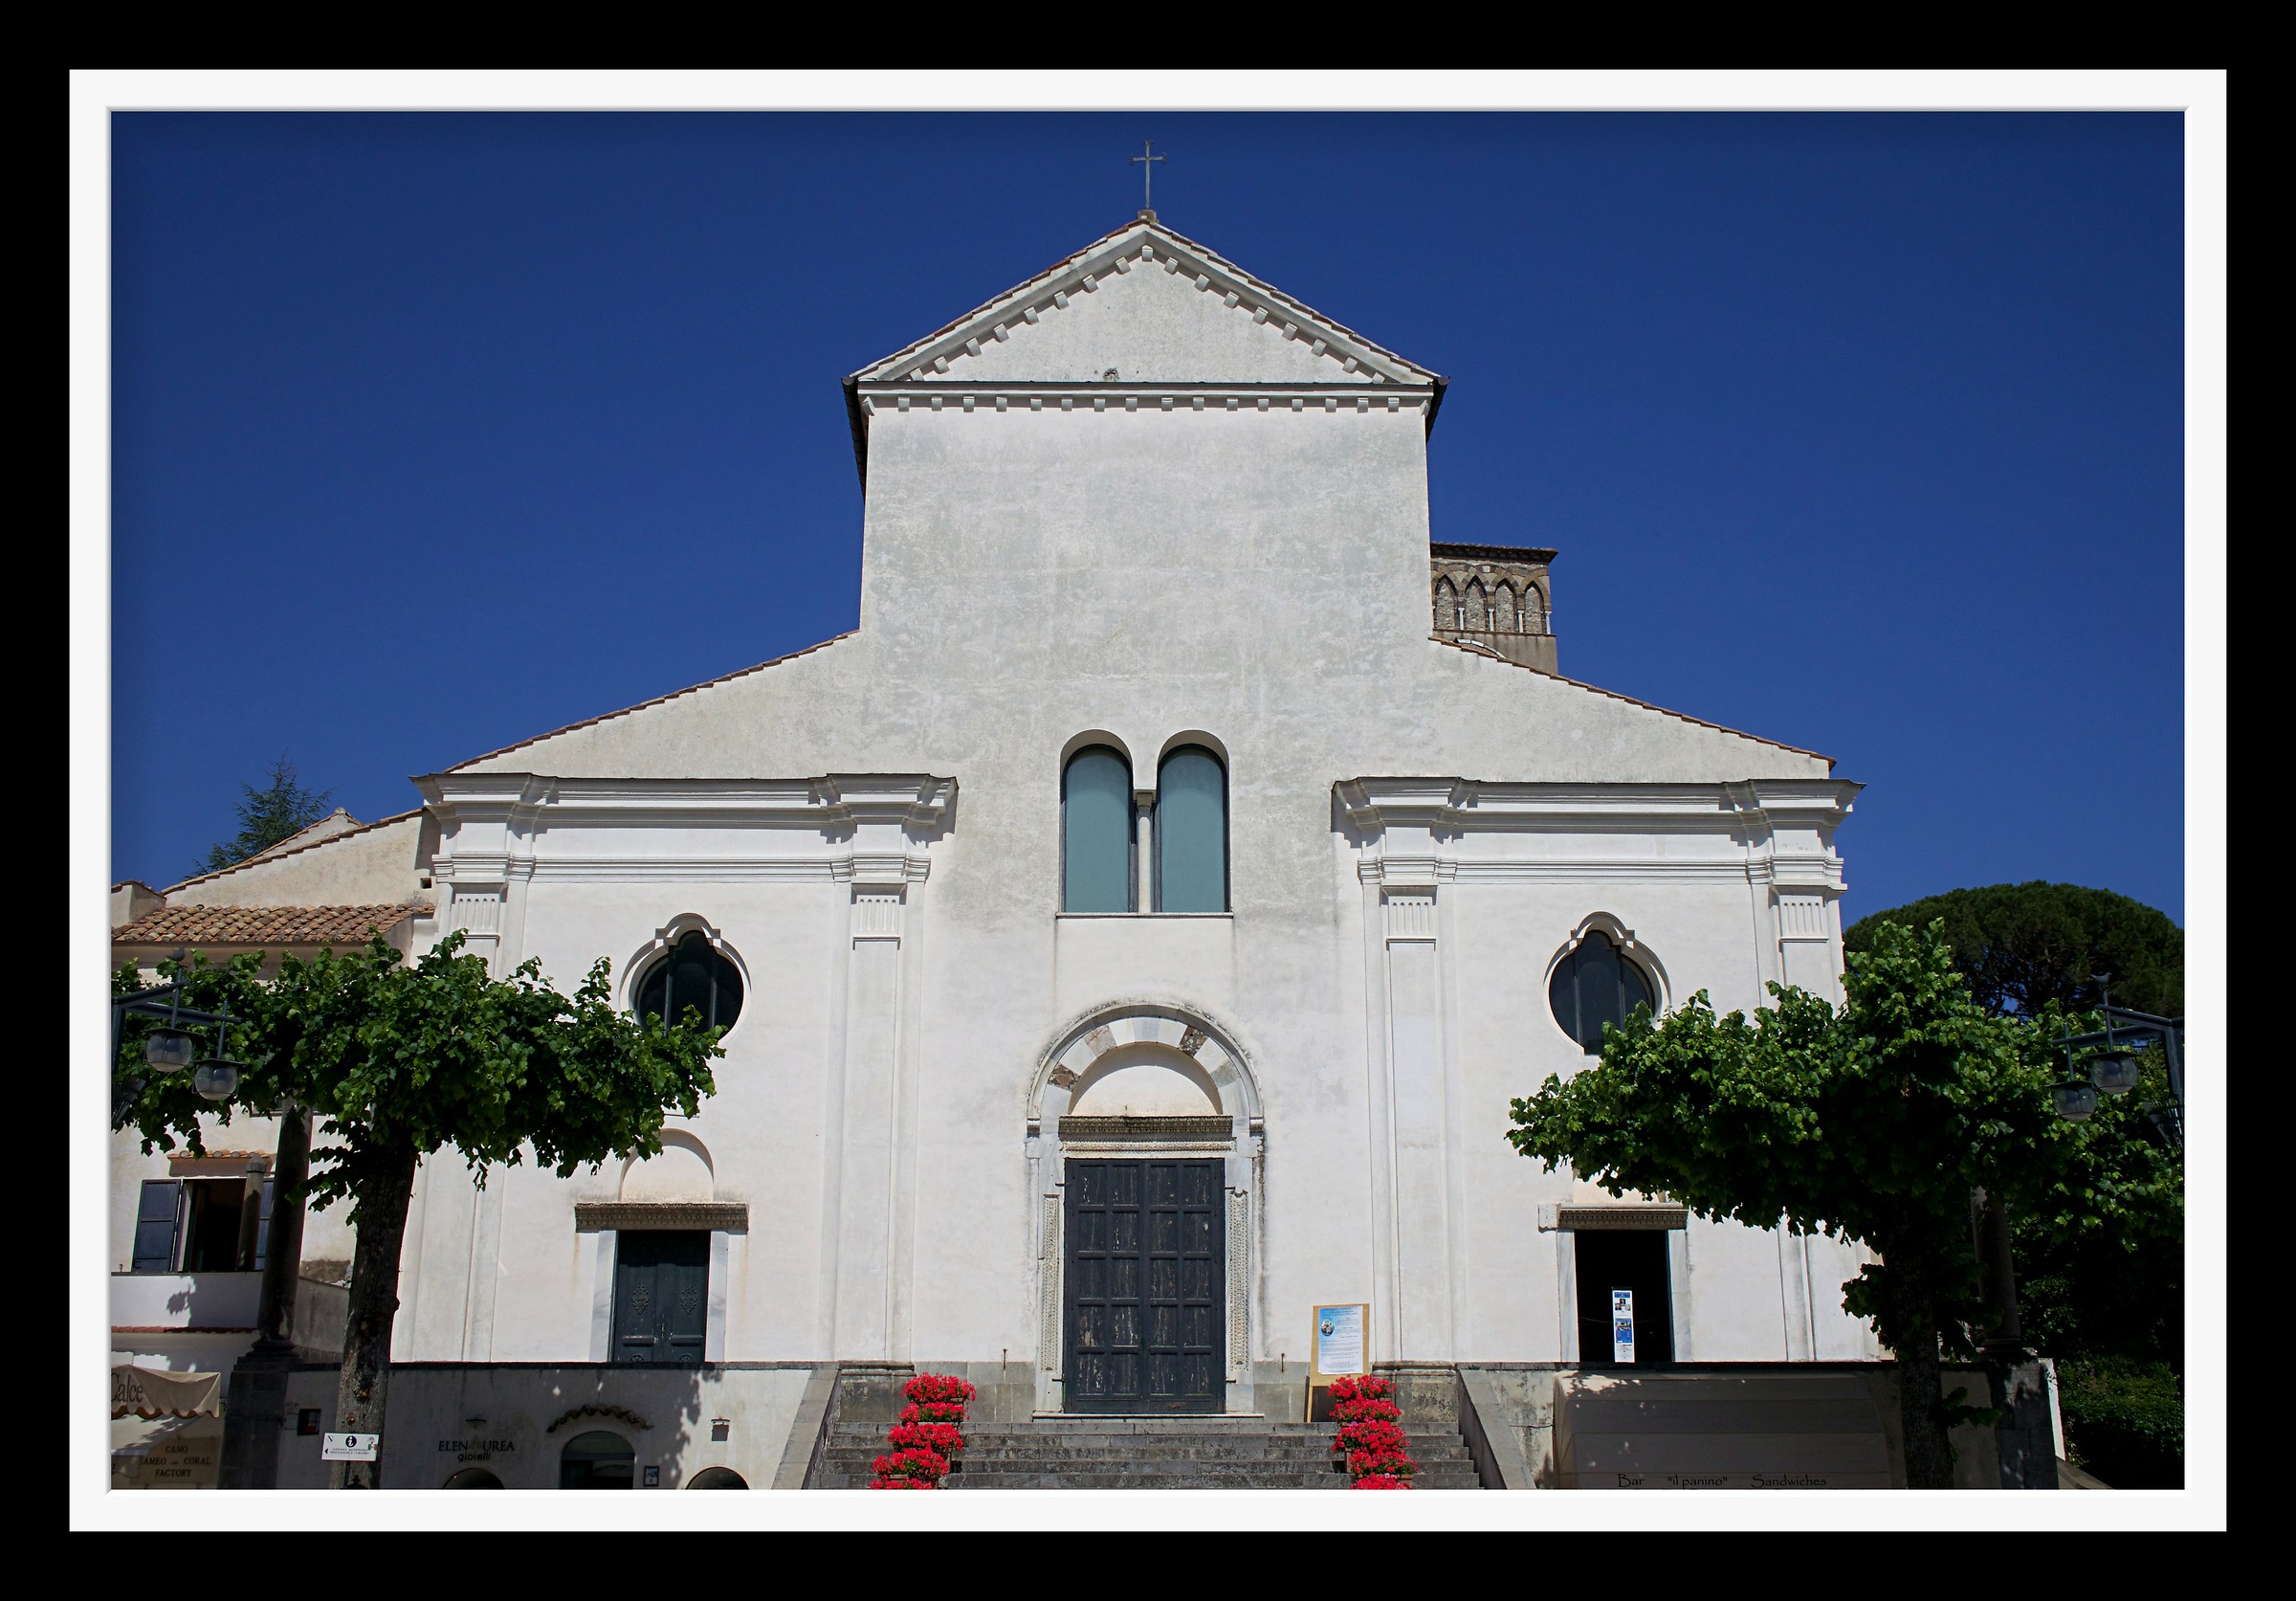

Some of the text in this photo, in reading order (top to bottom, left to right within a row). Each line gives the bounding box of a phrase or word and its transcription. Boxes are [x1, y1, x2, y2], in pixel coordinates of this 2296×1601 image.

[184, 1456, 212, 1465] CORAL
[457, 1452, 491, 1462] gioielli
[155, 1468, 192, 1478] FACTORY
[1618, 1474, 1644, 1487] Bar
[1751, 1475, 1827, 1488] Sandwiches
